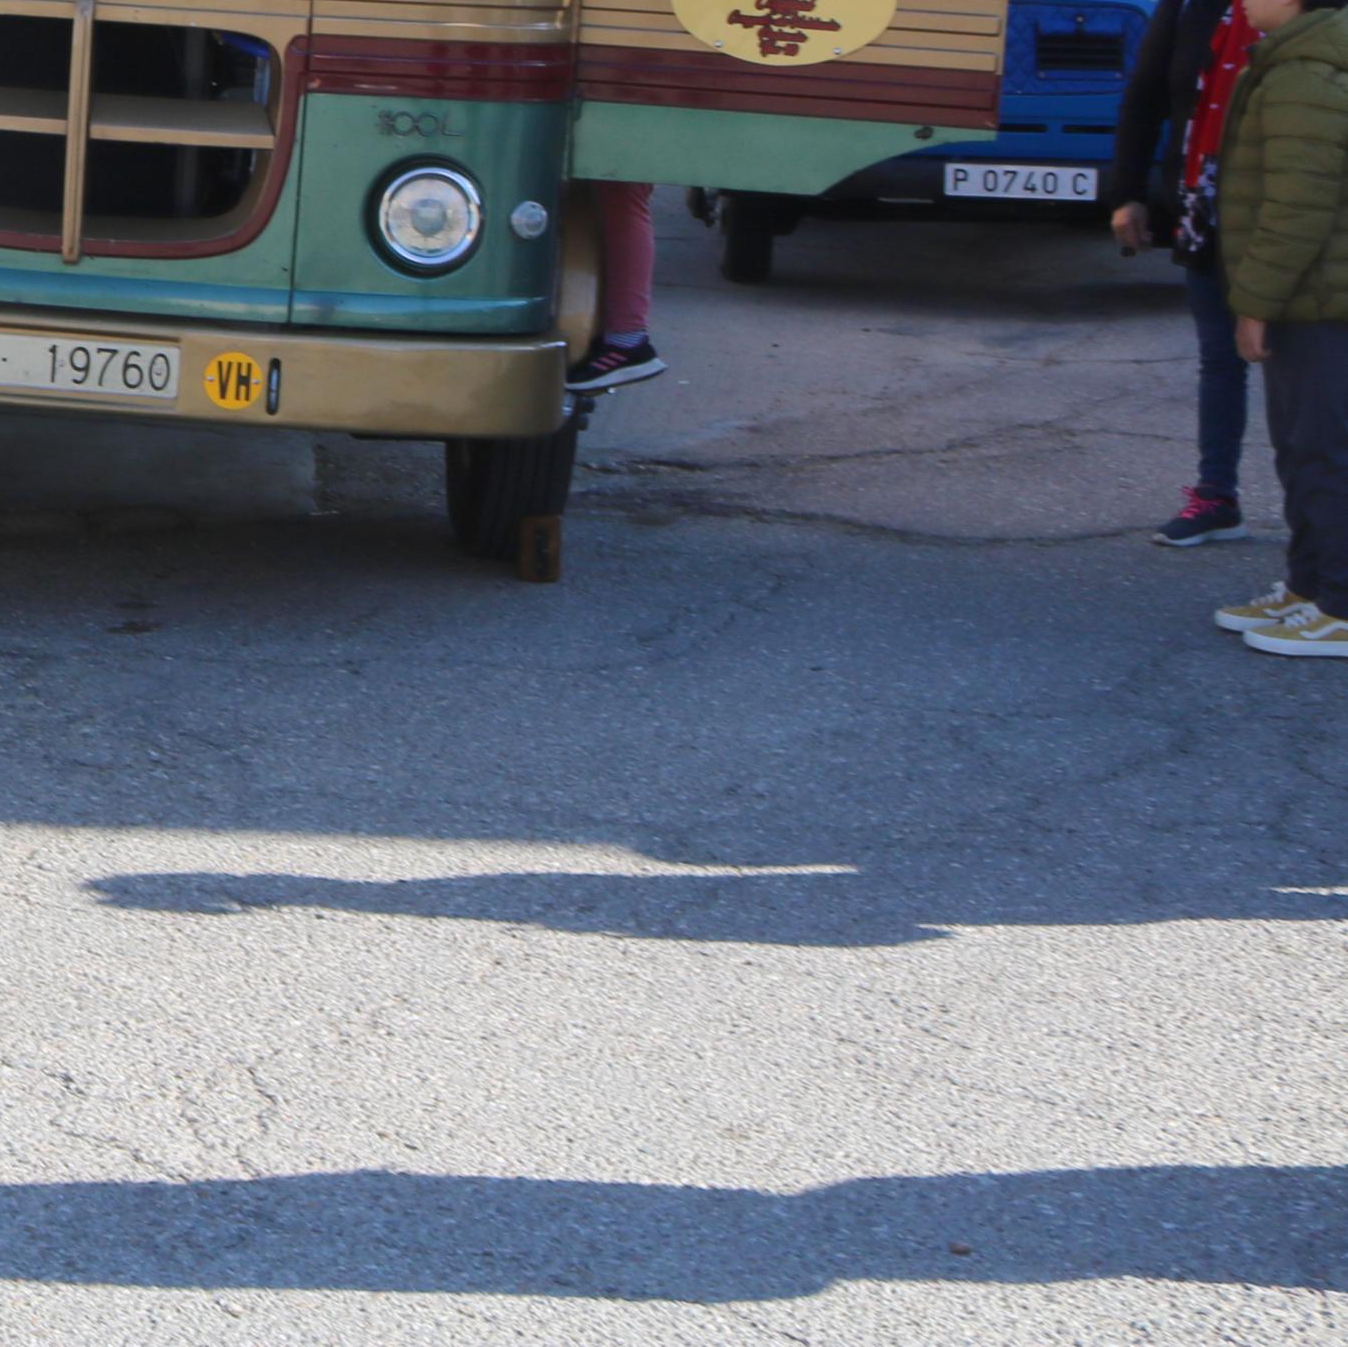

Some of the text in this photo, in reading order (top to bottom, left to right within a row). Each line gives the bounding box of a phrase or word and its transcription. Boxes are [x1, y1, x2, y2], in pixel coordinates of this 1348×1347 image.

[953, 168, 1088, 195] P 0740 C
[48, 344, 171, 391] 19760
[217, 360, 253, 401] VH
